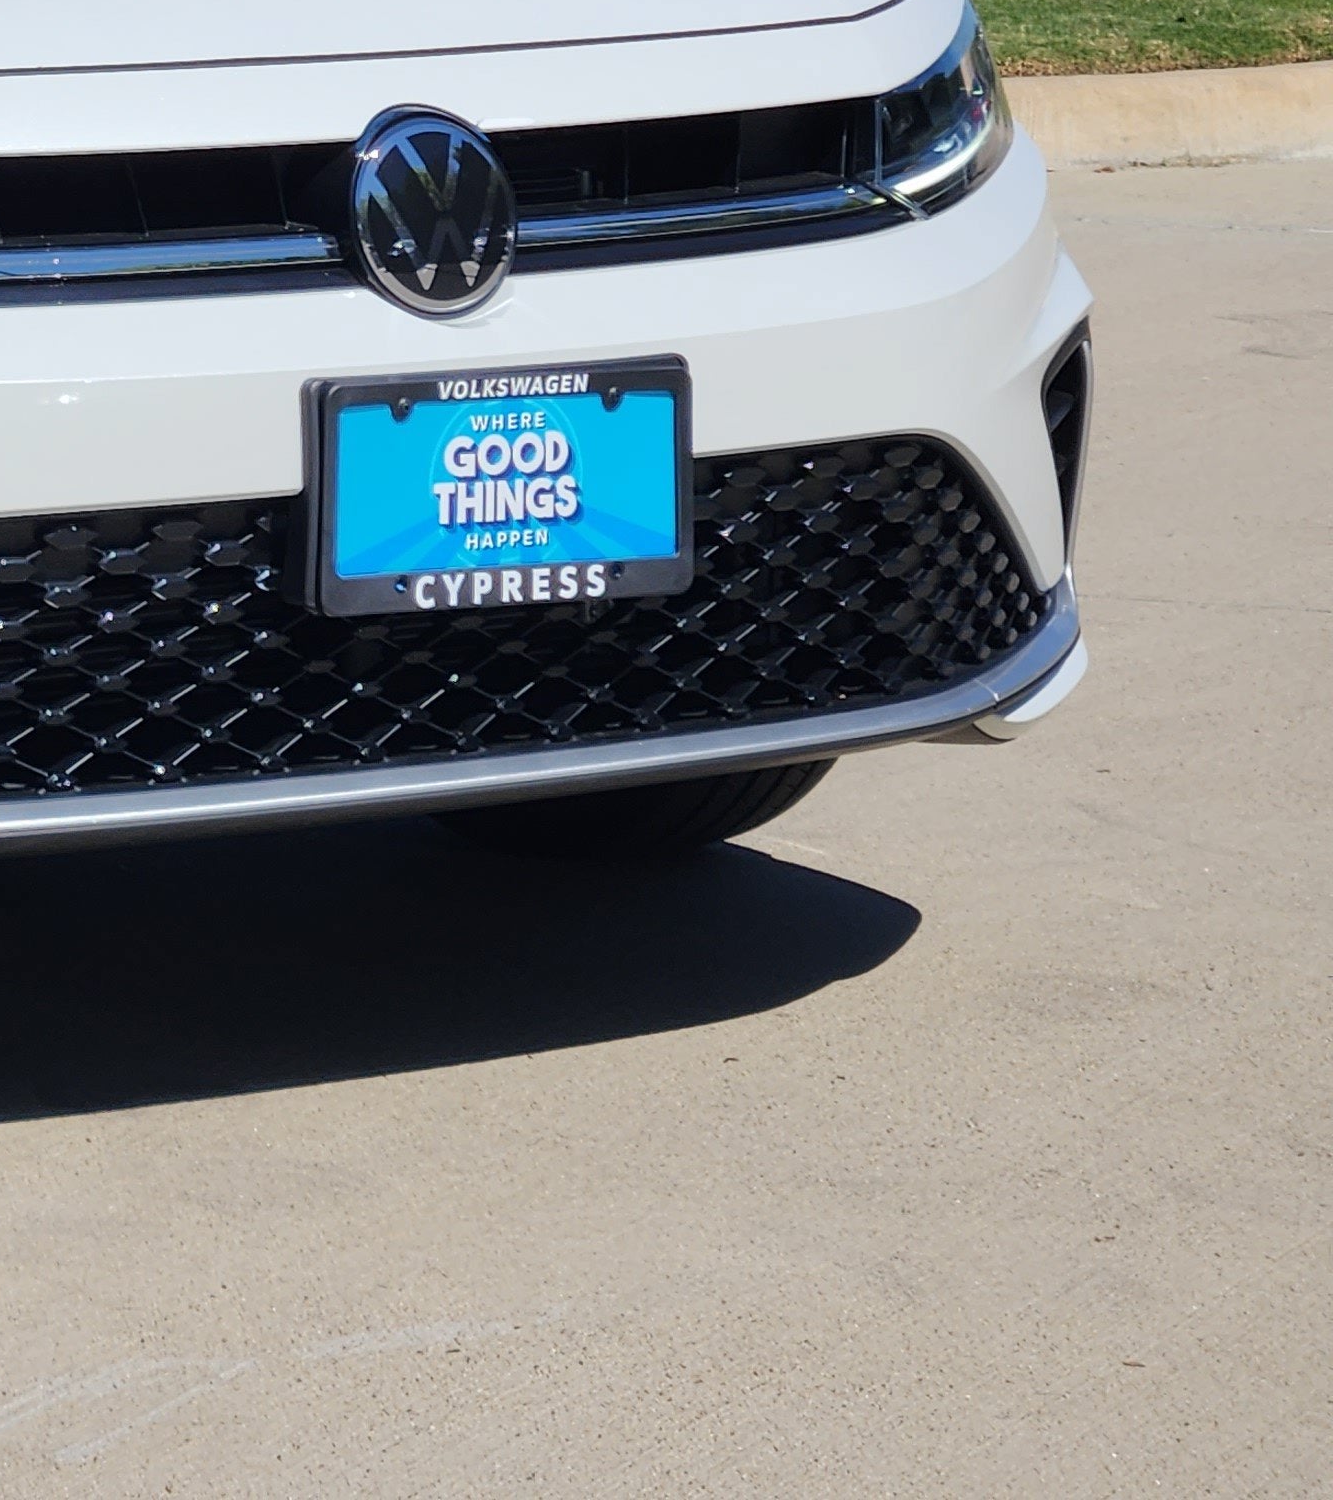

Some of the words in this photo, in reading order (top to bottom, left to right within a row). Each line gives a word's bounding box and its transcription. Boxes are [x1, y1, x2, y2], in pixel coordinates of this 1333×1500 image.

[437, 373, 590, 401] VOLKSWAGEN
[470, 411, 547, 431] WHERE
[444, 430, 571, 478] GOOD
[433, 476, 582, 526] THINGS
[464, 529, 551, 551] HAPPEN
[414, 564, 607, 610] CYPRESS
